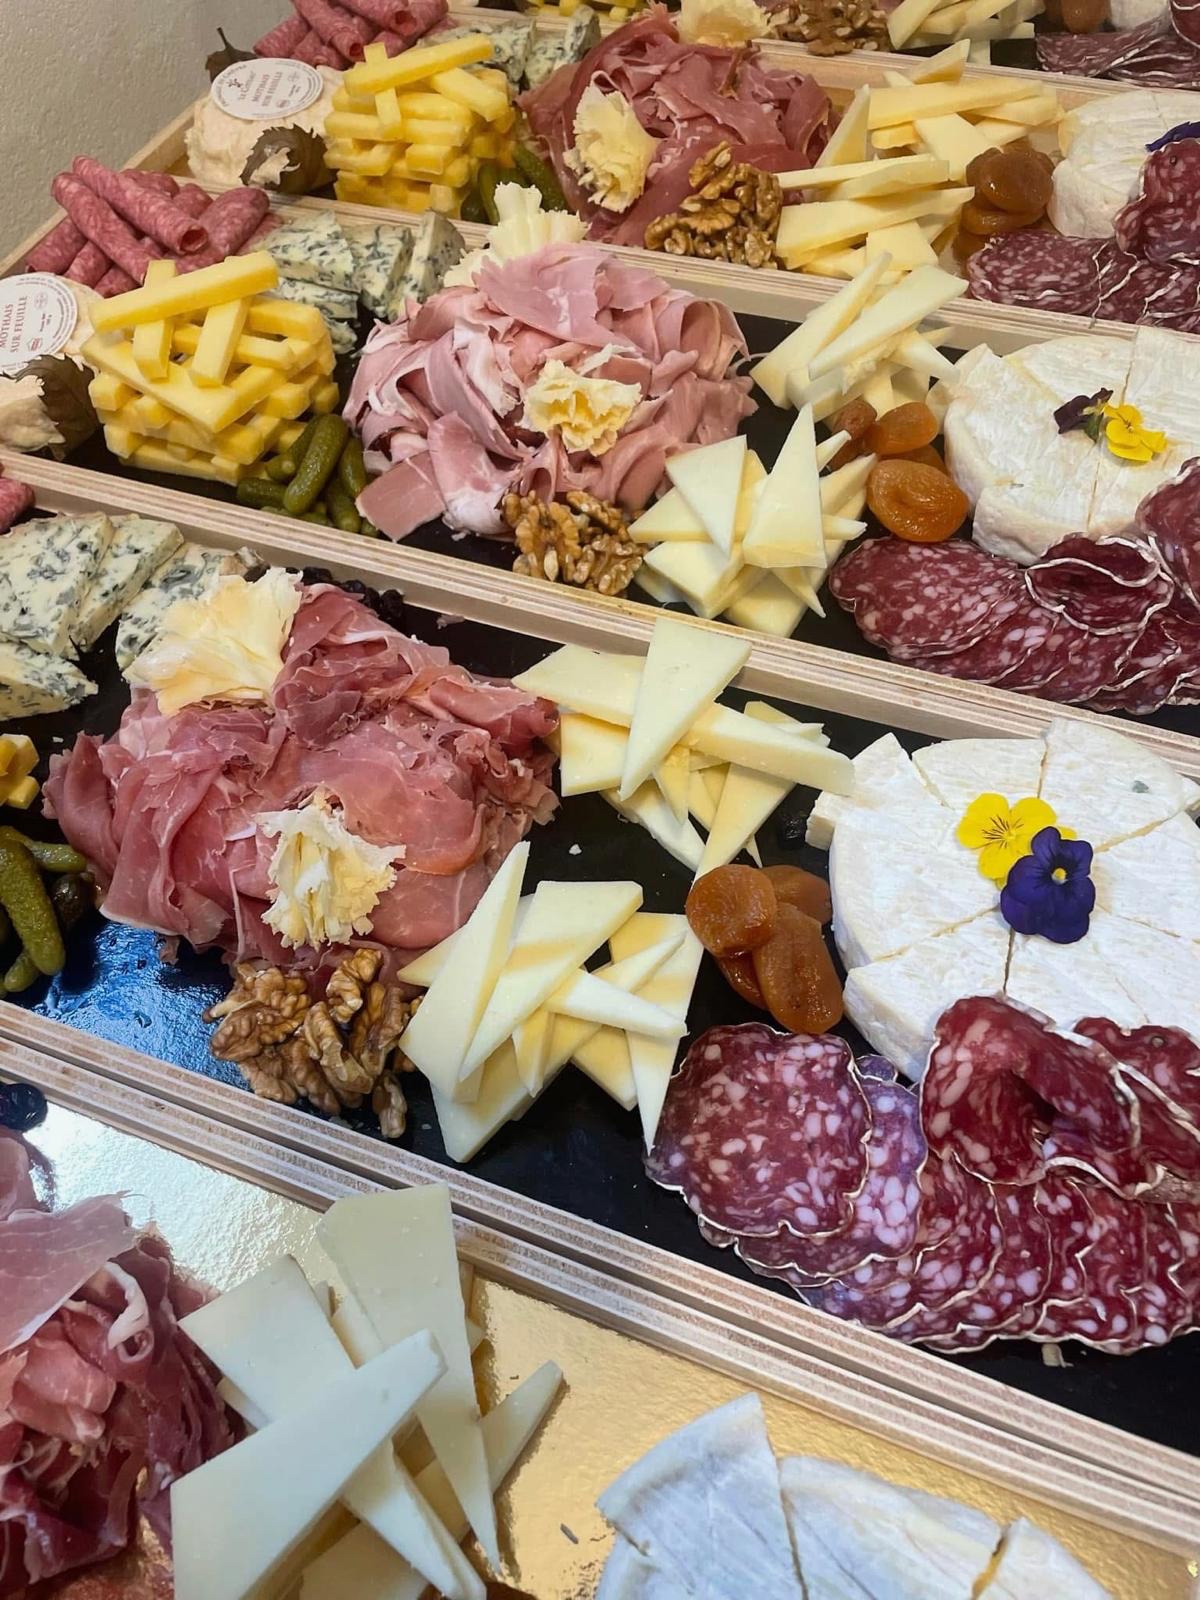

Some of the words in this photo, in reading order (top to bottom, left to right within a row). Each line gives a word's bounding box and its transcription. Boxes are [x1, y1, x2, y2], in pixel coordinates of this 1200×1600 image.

[0, 304, 13, 347] MOTHAIS
[14, 296, 28, 332] FEUILLE
[10, 334, 21, 353] SUR
